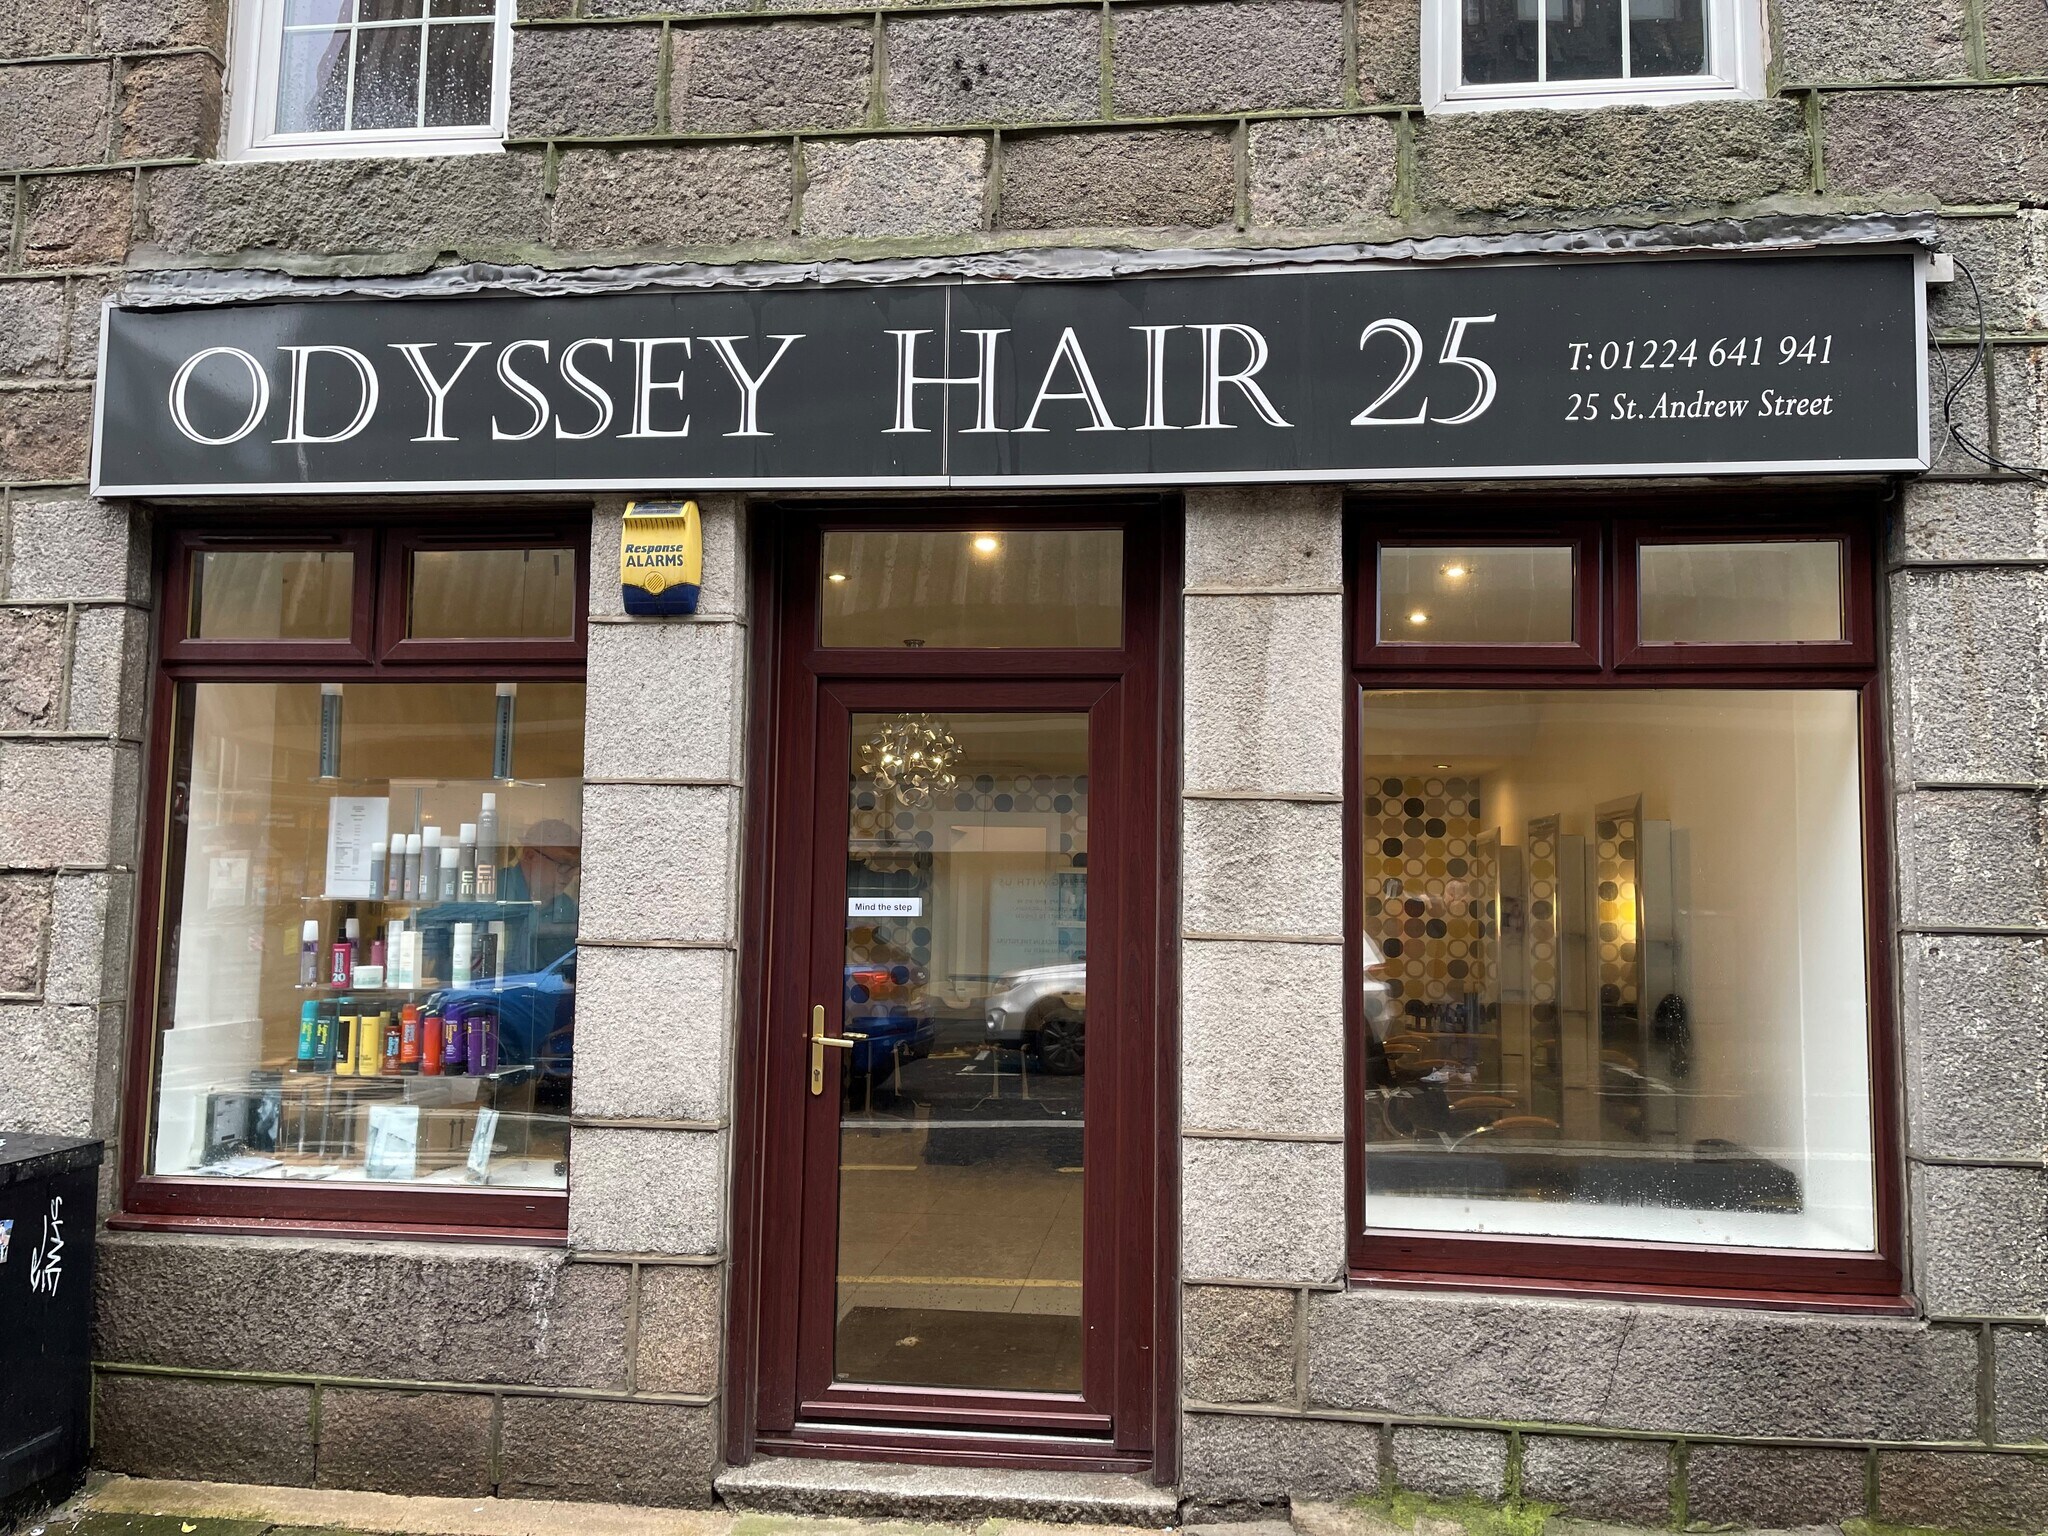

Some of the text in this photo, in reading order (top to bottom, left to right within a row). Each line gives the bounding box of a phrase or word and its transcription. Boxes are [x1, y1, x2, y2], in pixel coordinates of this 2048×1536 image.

[1708, 336, 1763, 367] 641
[1778, 334, 1832, 365] 941
[168, 313, 1497, 446] ODYSSEY HAIR 25
[1564, 392, 1600, 421] 25
[1648, 389, 1750, 419] Andrew
[1758, 388, 1834, 417] Street
[625, 544, 683, 554] Response
[626, 554, 684, 567] ALARMS
[855, 903, 913, 912] Mind the step
